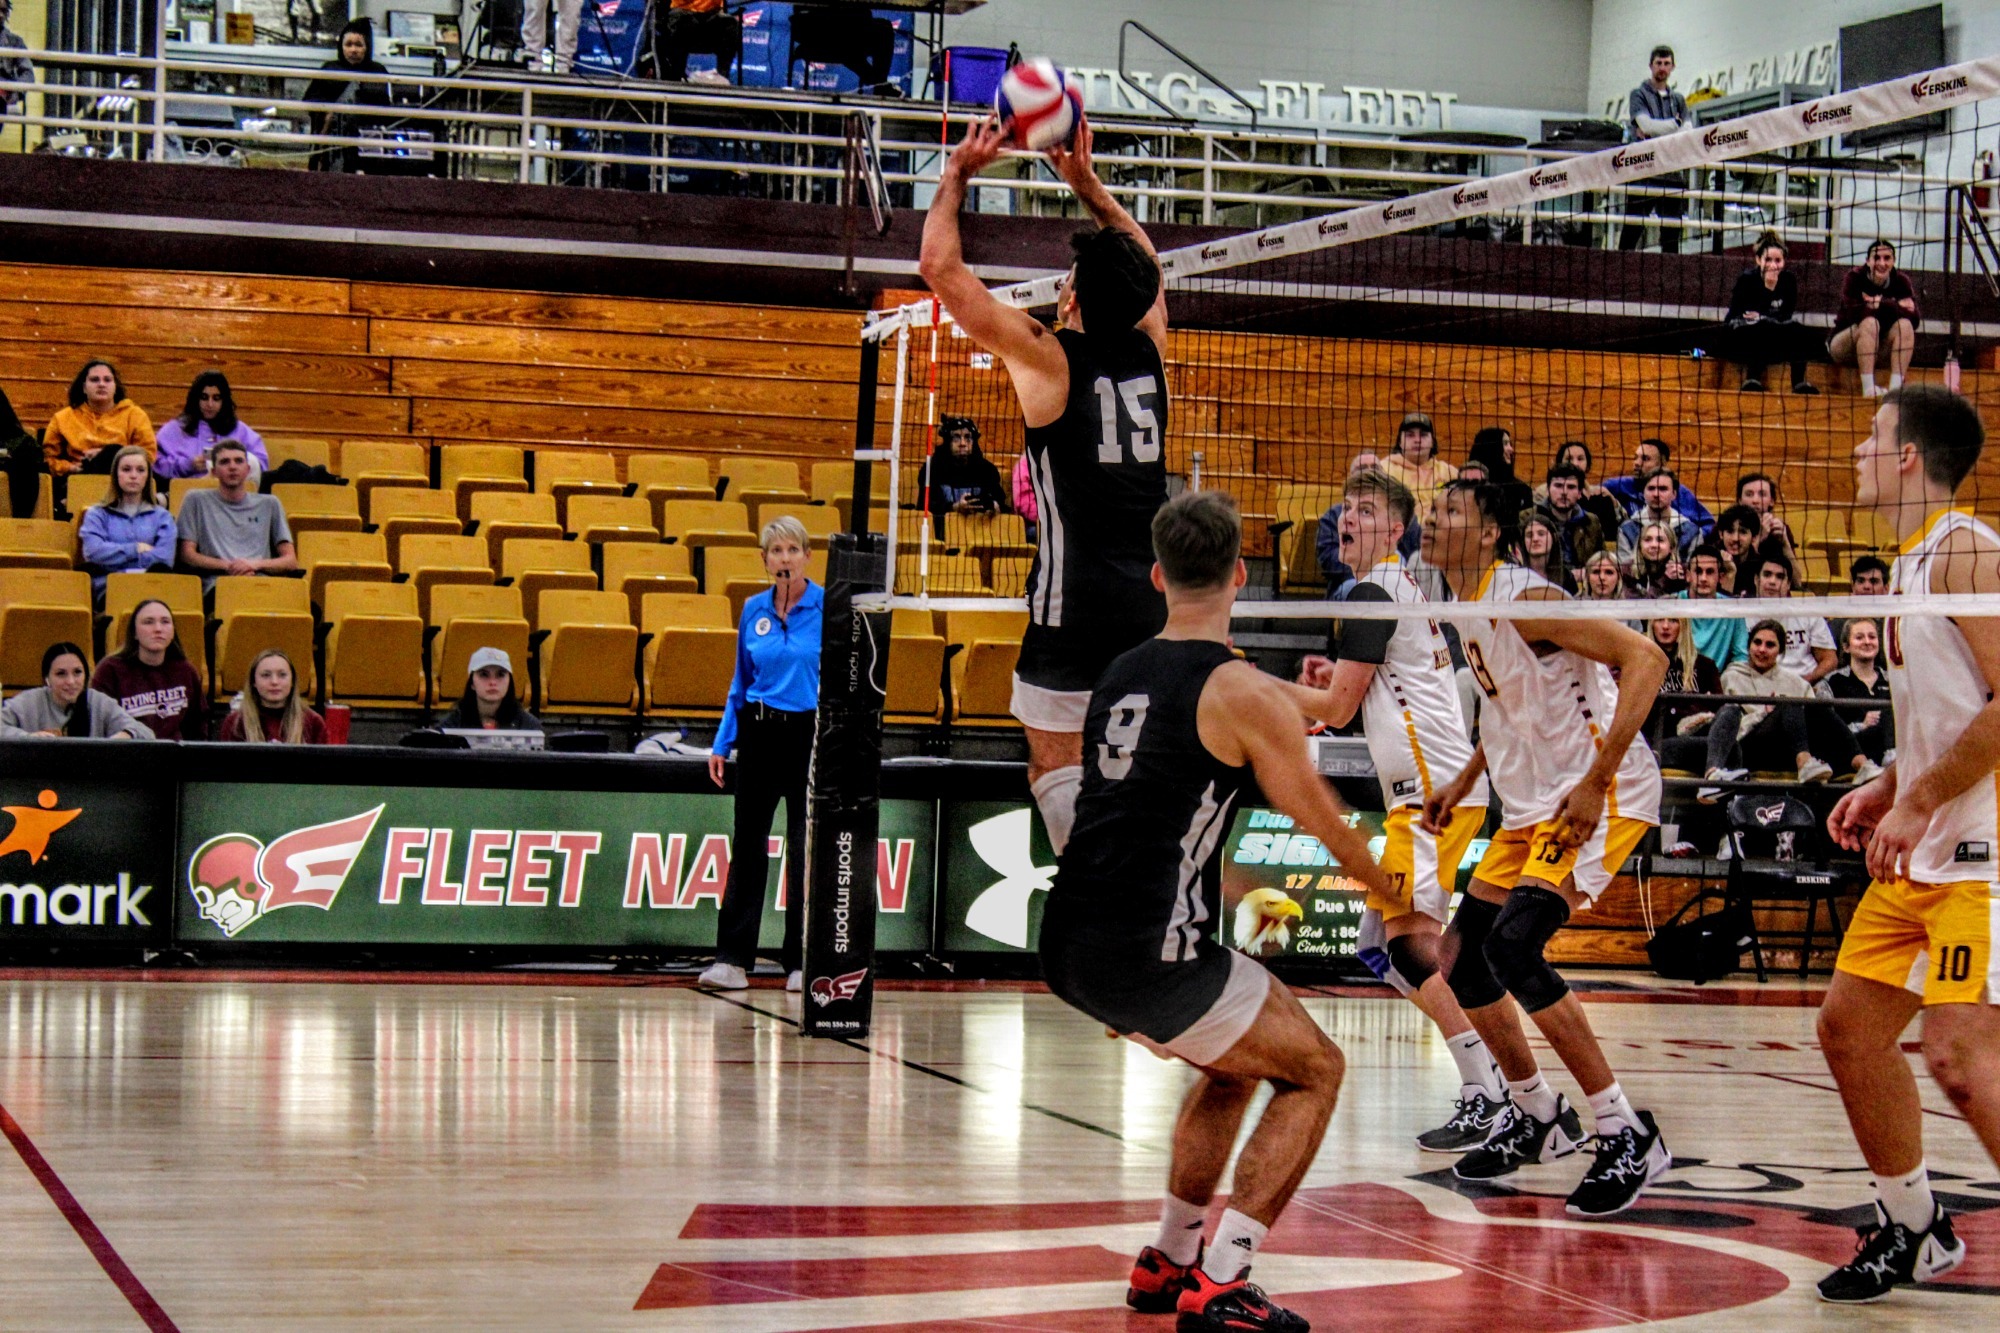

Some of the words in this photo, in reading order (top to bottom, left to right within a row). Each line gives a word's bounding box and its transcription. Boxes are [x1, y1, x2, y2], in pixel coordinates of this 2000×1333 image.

[1929, 76, 1968, 96] ERSKINE
[1818, 104, 1852, 123] ERSKINE
[1717, 129, 1748, 146] ERSKINE
[1624, 151, 1655, 167] ERSKINE
[1541, 172, 1568, 186] ERSKINE
[1464, 190, 1488, 203] ERSKINE
[1393, 206, 1416, 219] ERSKINE
[1094, 375, 1160, 463] 15
[121, 691, 156, 711] FLYING
[156, 686, 187, 703] FLEET
[1097, 693, 1151, 780] 9
[1248, 809, 1296, 829] Due
[379, 827, 602, 907] FLEET
[836, 831, 853, 886] sports
[1285, 874, 1313, 890] 17
[1796, 875, 1831, 885] ERSKINE
[1314, 899, 1346, 914] Due
[833, 887, 851, 954] imports
[1339, 943, 1359, 955] 86
[1936, 944, 1972, 982] 10
